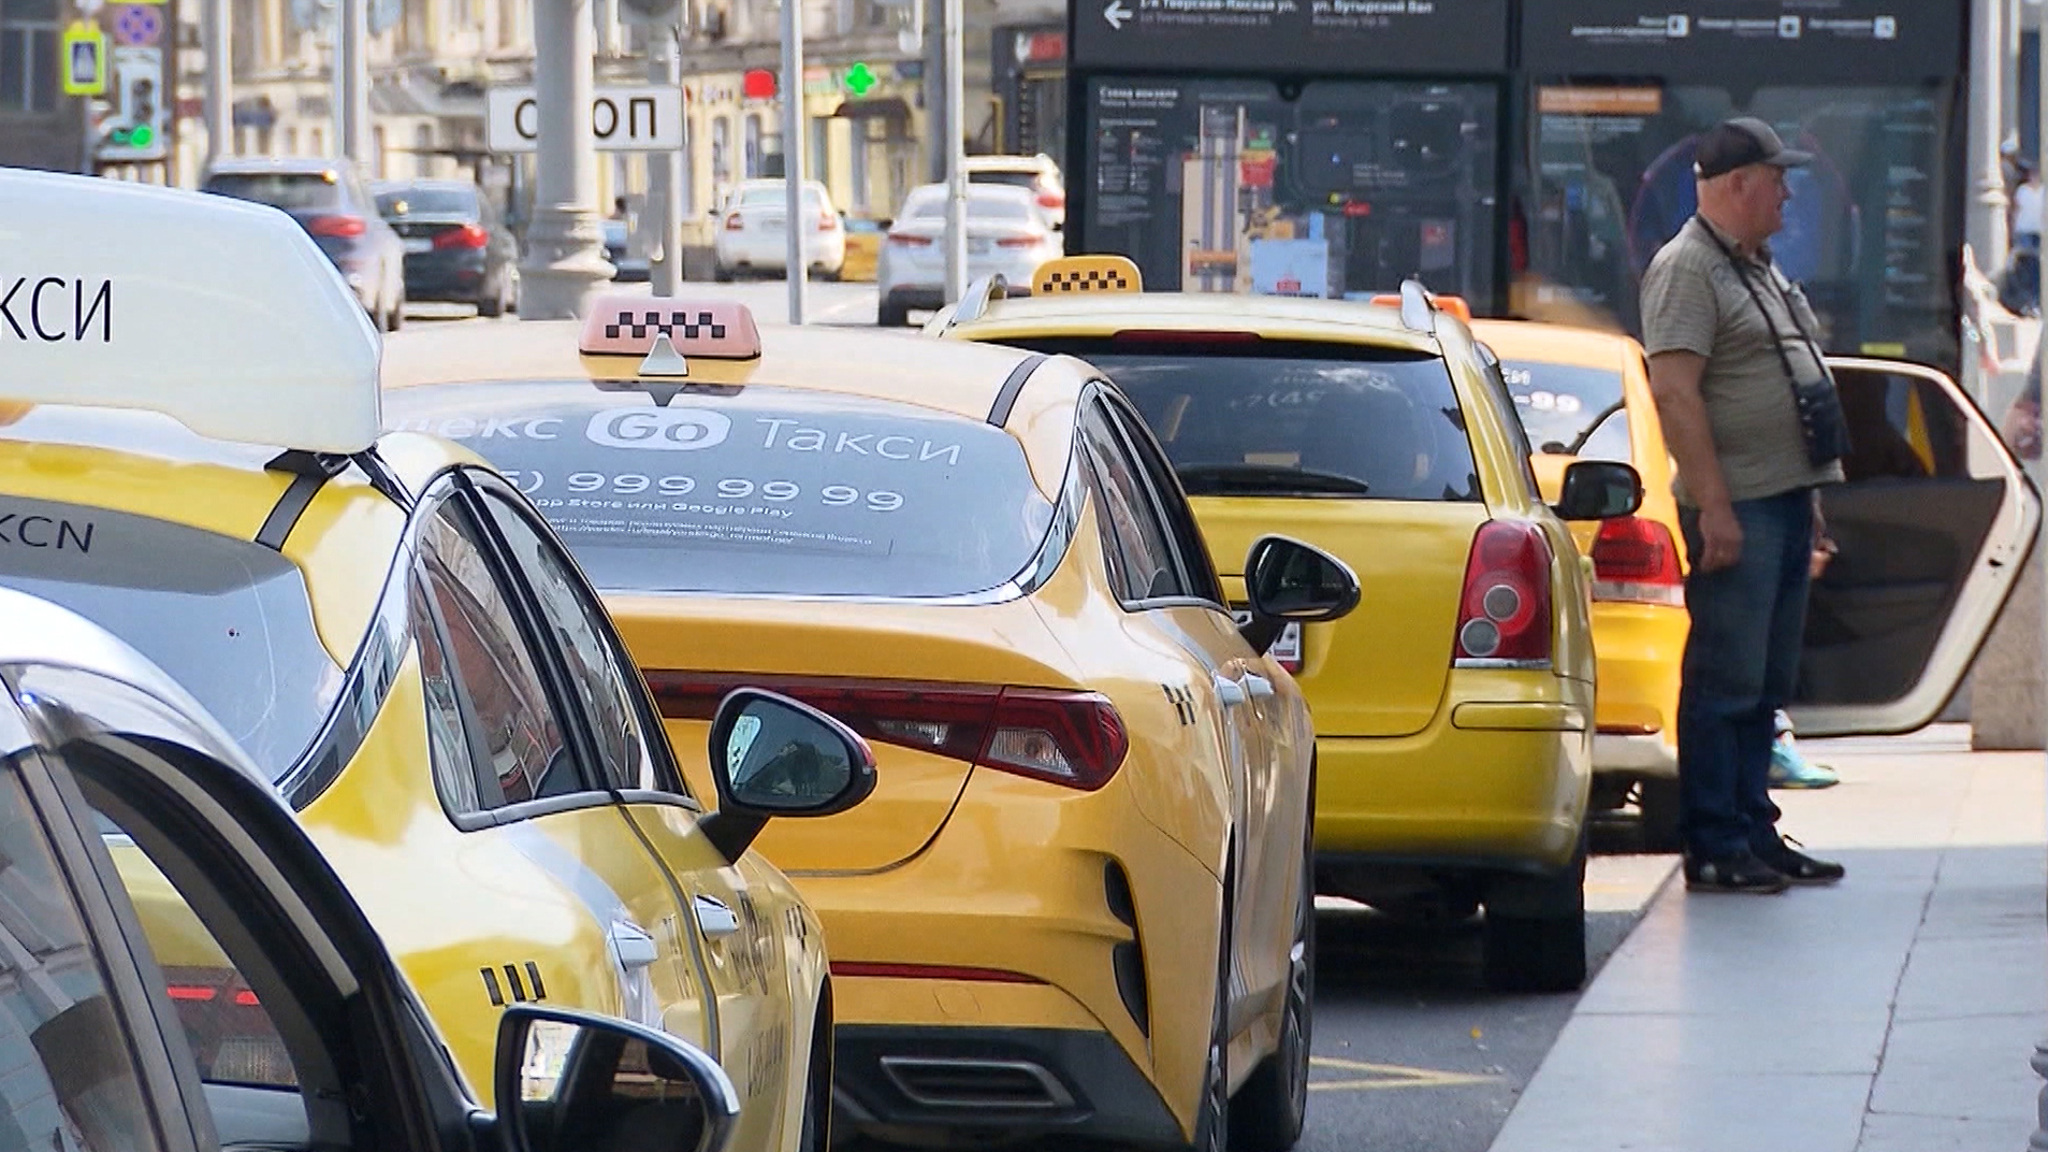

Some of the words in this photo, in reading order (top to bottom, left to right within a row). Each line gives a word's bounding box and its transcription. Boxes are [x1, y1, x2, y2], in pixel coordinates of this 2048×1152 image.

[514, 97, 657, 140] СОП
[607, 412, 709, 442] Go
[755, 418, 962, 466] Такси
[530, 498, 564, 509] pp
[567, 498, 624, 510] Store
[671, 502, 746, 517] Google
[750, 506, 794, 519] Play
[567, 472, 697, 496] 999
[717, 478, 801, 501] 99
[821, 485, 905, 511] 99
